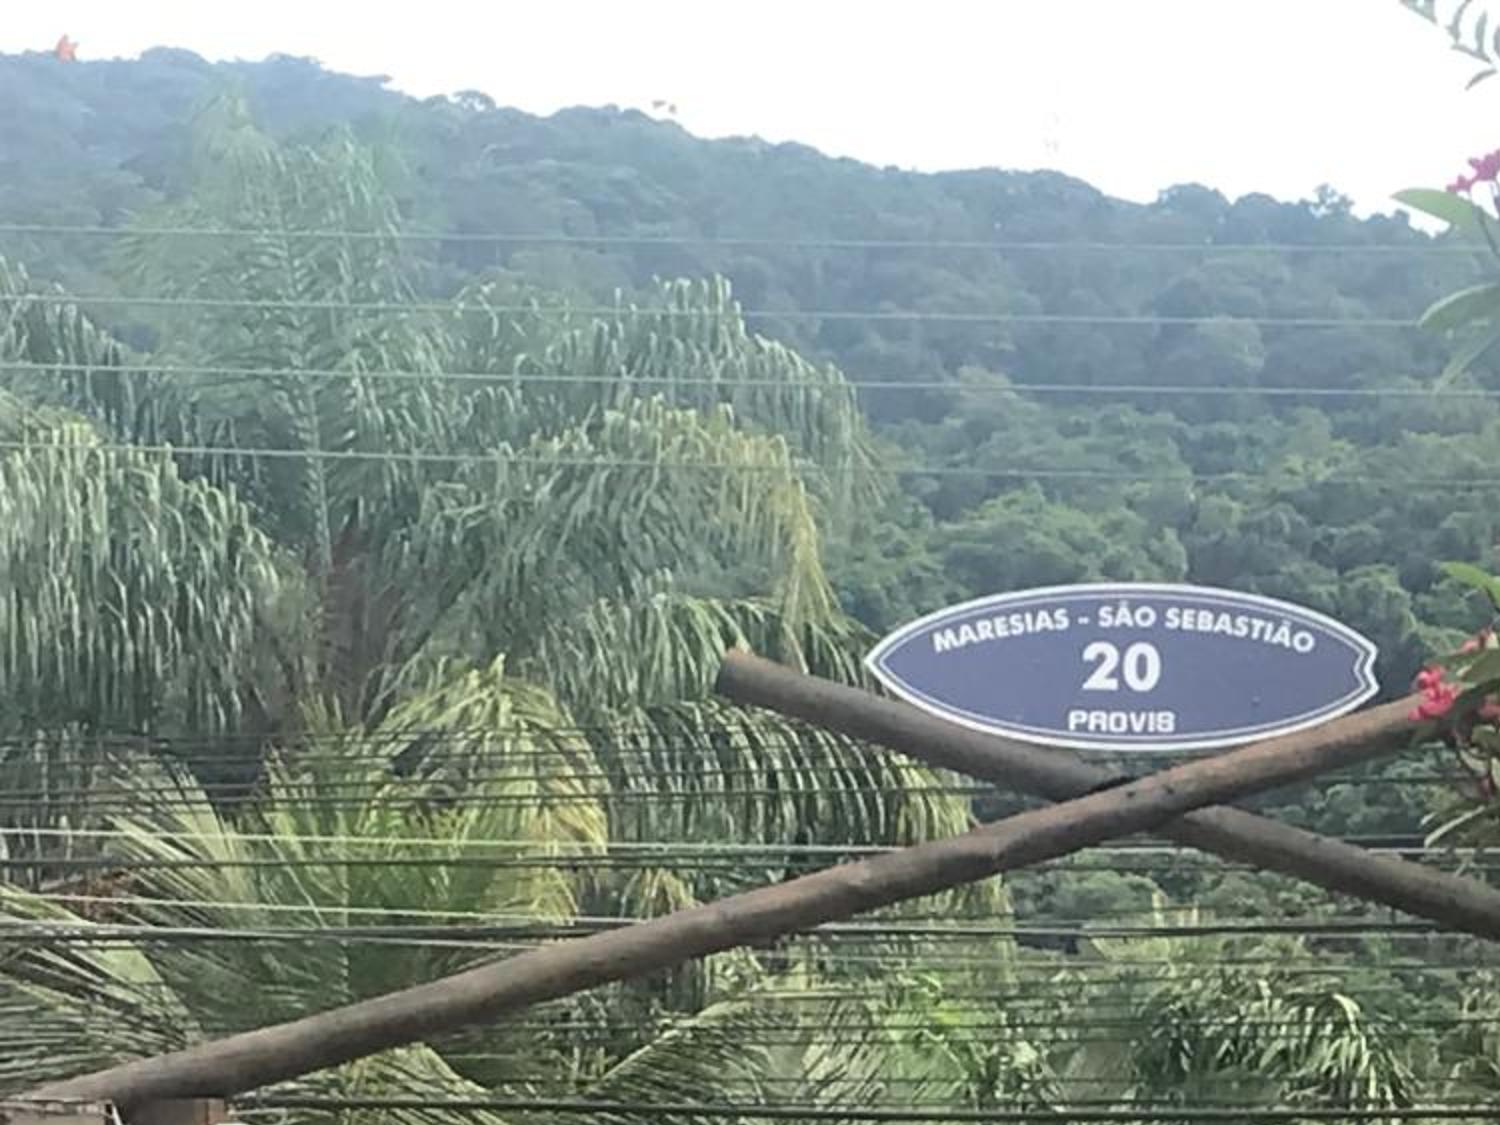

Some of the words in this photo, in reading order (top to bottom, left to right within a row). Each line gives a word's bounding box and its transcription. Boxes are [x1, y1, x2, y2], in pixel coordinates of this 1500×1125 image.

[932, 607, 1070, 653] MARESIAS
[1097, 600, 1157, 629] SÃO
[1164, 606, 1316, 653] SEBASTIÃO
[1081, 640, 1162, 693] 20
